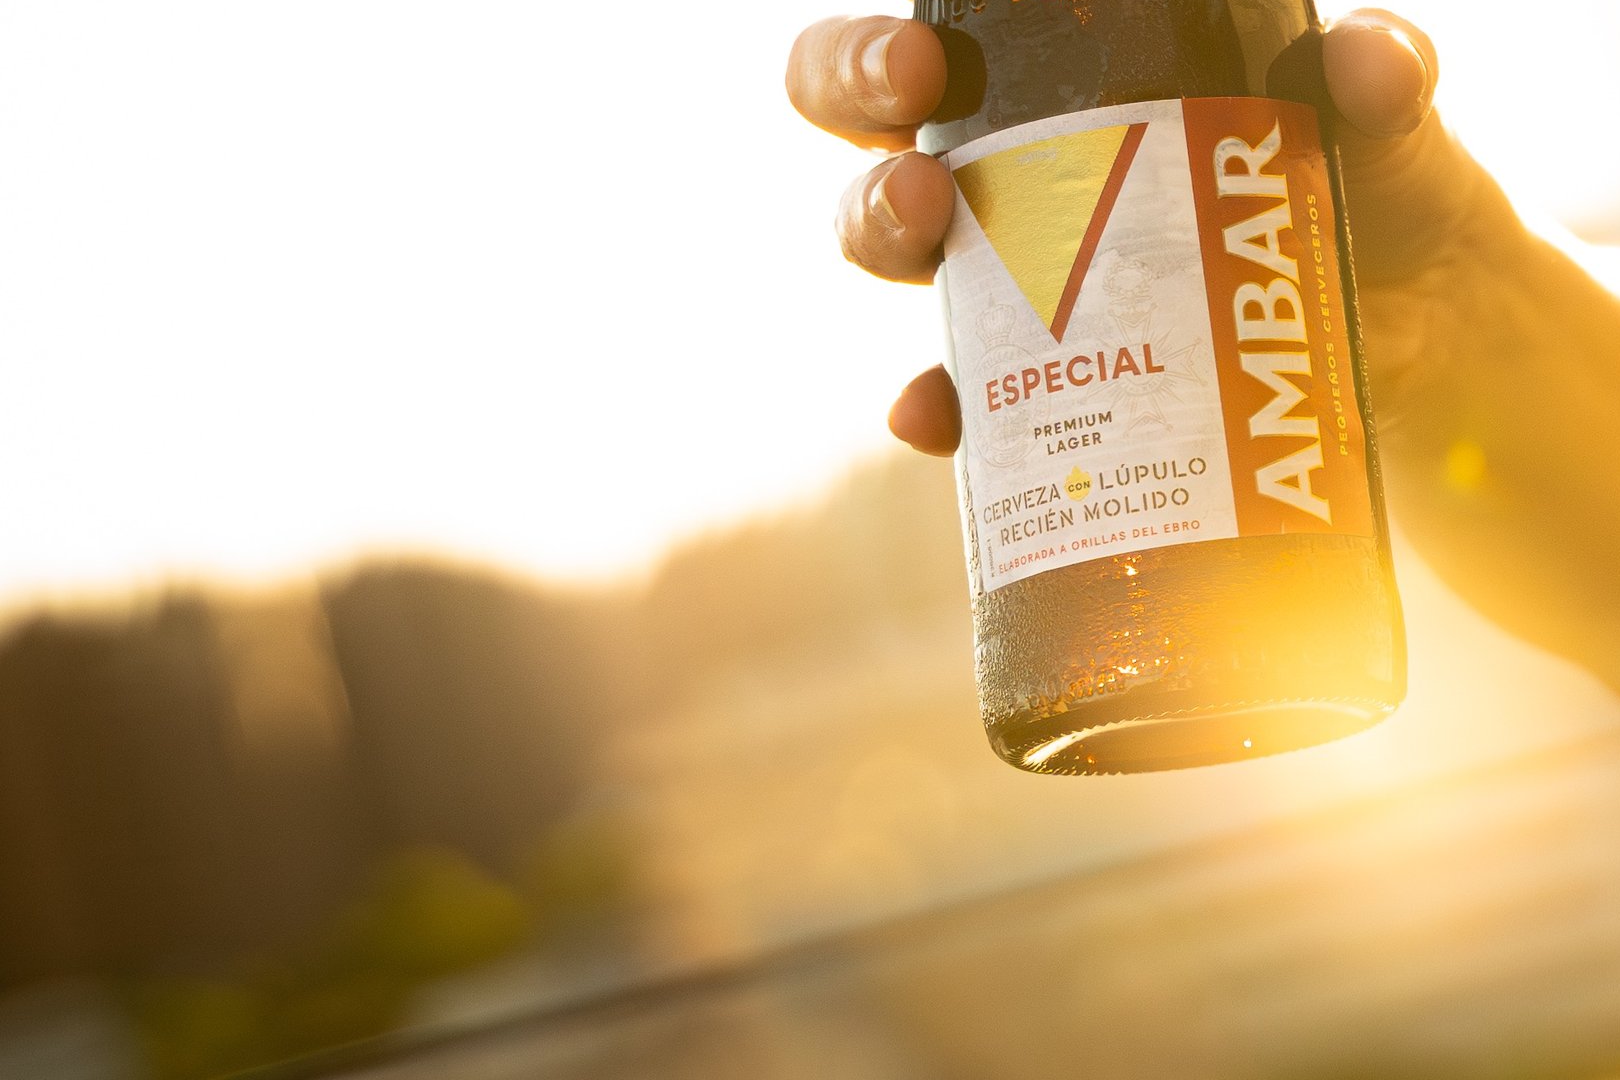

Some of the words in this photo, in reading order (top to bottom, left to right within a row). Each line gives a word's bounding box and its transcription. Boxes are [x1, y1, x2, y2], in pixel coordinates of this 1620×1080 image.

[1306, 193, 1332, 332] CERVECEROS
[1213, 115, 1333, 526] AMBAR
[985, 343, 1165, 413] ESPECIAL
[1325, 342, 1349, 456] PEQUEÑOS
[1033, 410, 1113, 440] PREMIUM
[1046, 431, 1103, 456] LAGER
[983, 483, 1062, 524] CERVEZA
[1067, 480, 1091, 493] CON
[1099, 457, 1207, 491] LÚPULO
[1000, 507, 1074, 547] RECIÉN
[1084, 487, 1190, 522] MOLIDO
[998, 547, 1056, 575] ELABORADA
[1059, 544, 1068, 555] A
[1071, 531, 1127, 551] ORILLAS
[1132, 526, 1158, 539] DEL
[1163, 519, 1201, 534] EBRO
